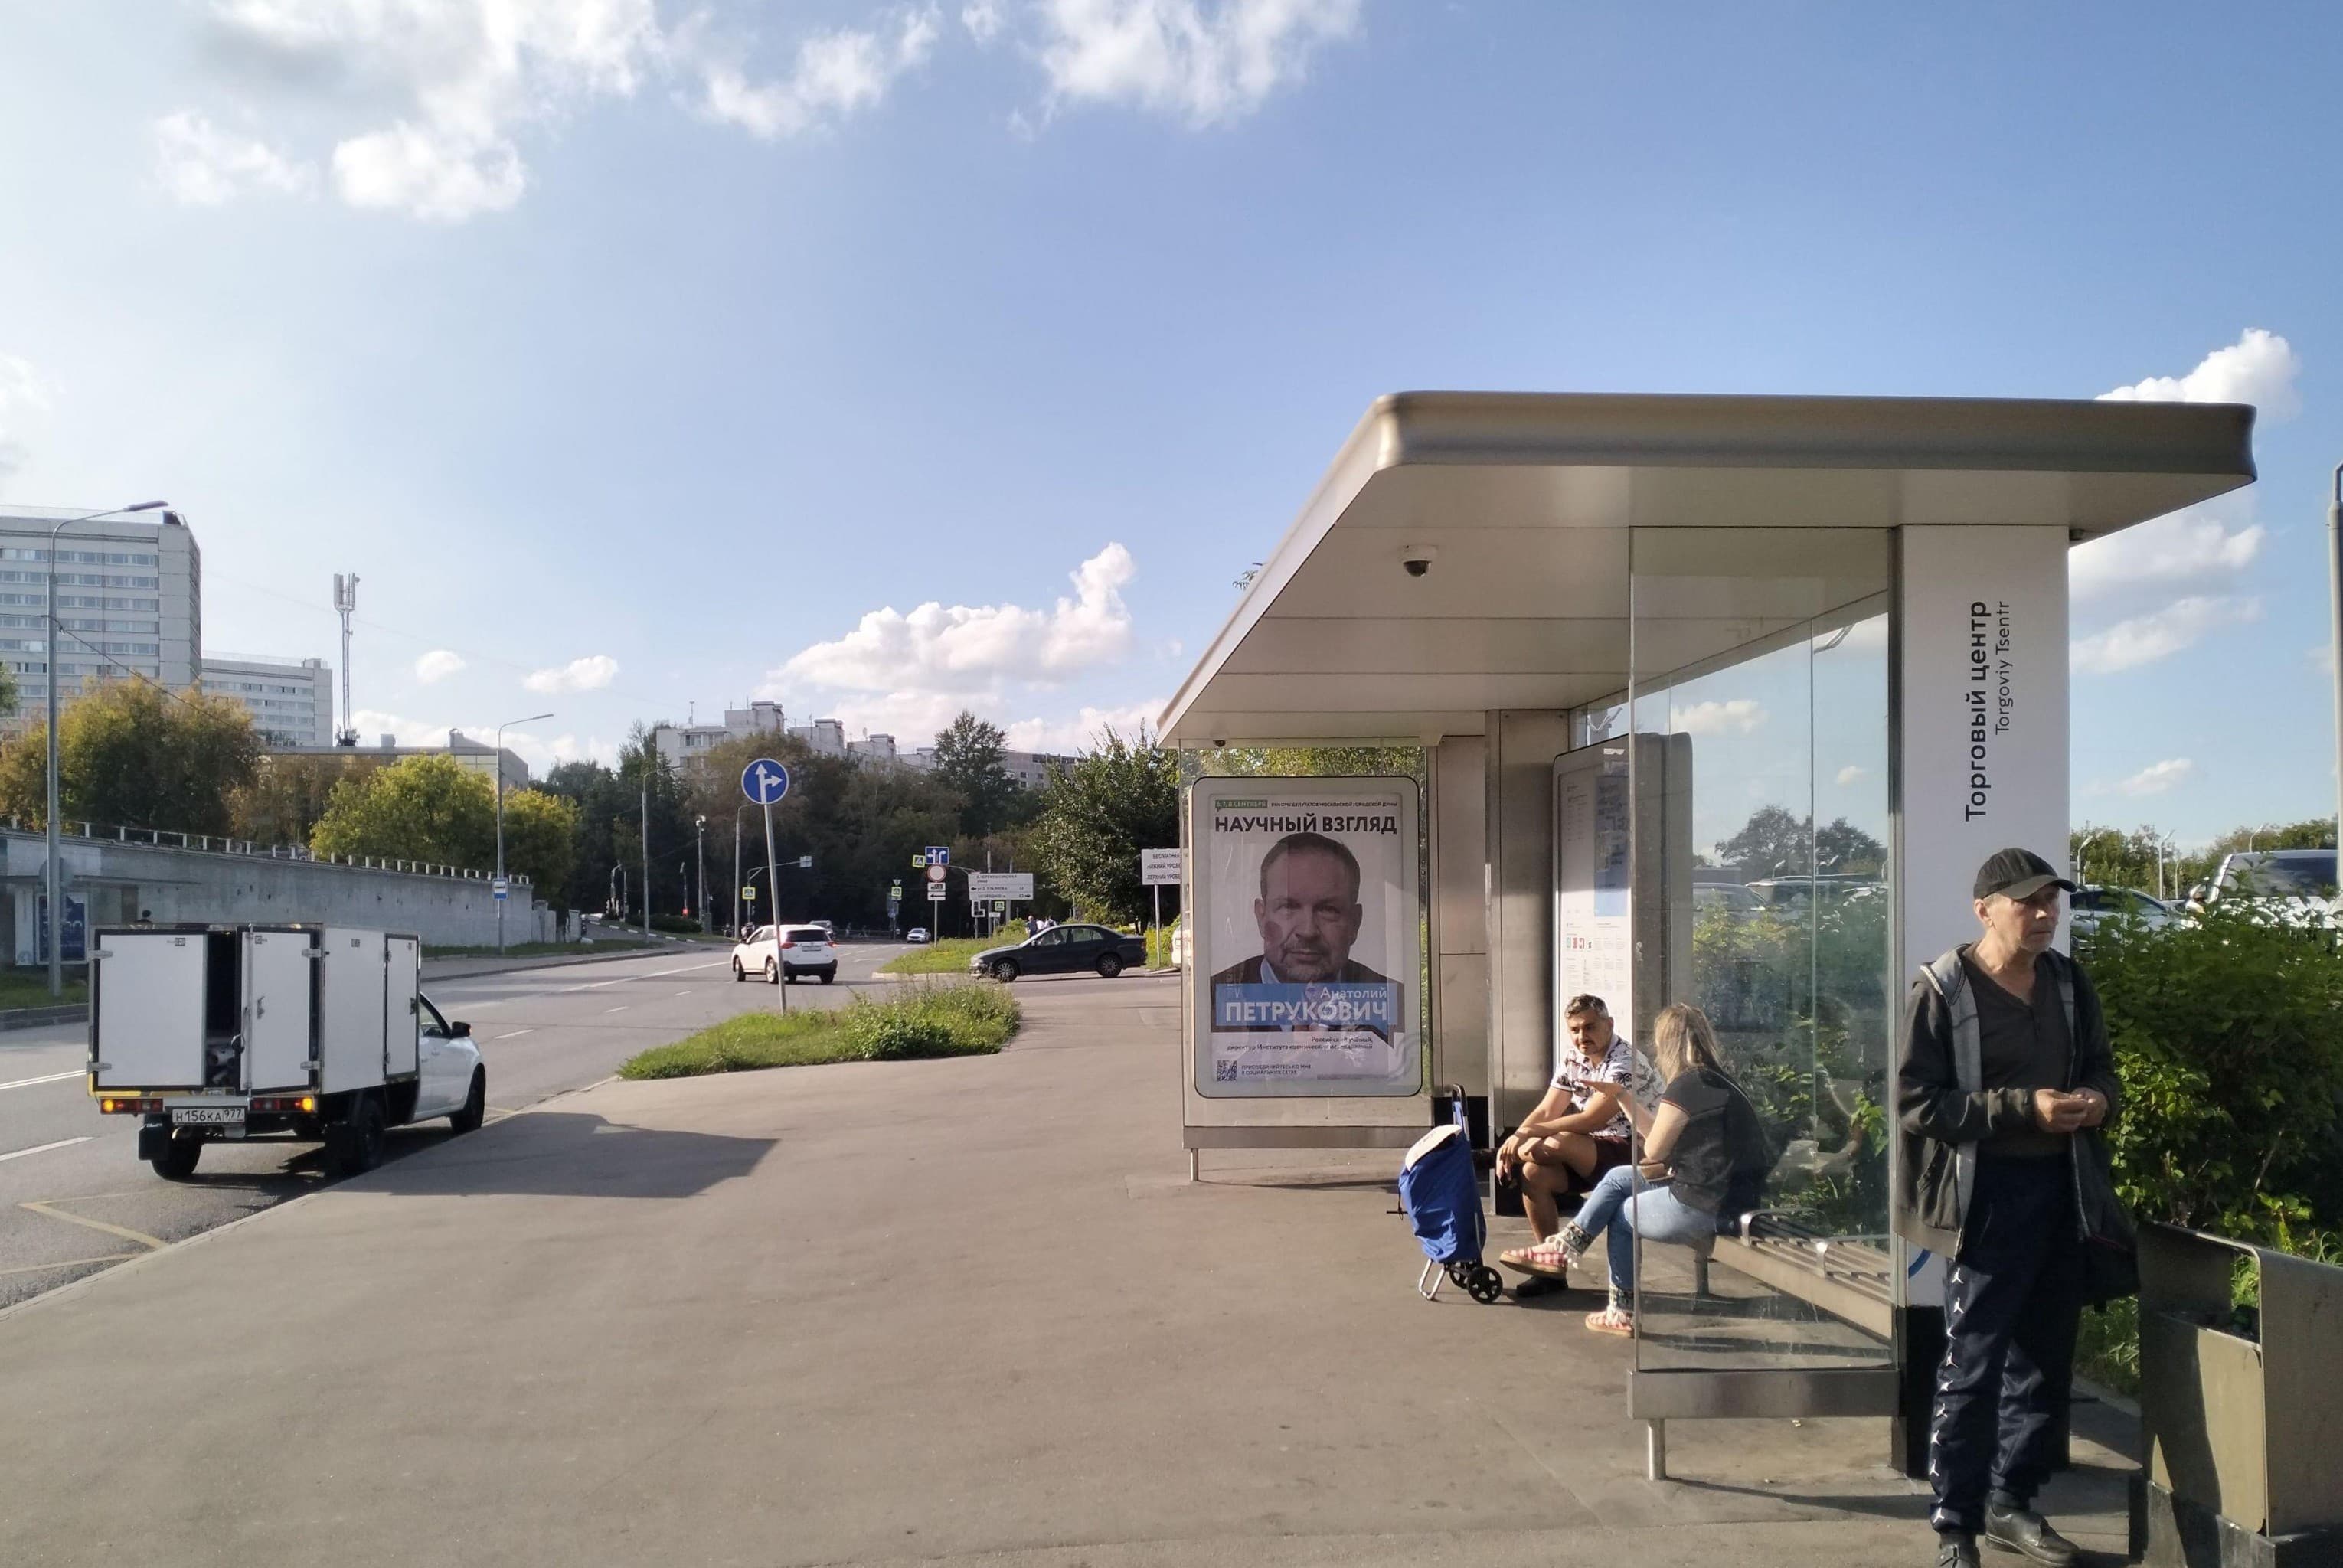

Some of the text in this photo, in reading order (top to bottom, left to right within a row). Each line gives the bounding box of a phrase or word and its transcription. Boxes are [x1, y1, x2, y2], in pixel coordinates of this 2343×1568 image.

[1995, 601, 2014, 735] Torgoviy Tsentr
[1966, 601, 1992, 822] Торговый центр
[1215, 813, 1397, 835] НАУЧНЫЙ ВЗГЛЯД
[1320, 986, 1387, 999] Анатолий
[1226, 1001, 1387, 1021] ПЕТРУКОВИЧ
